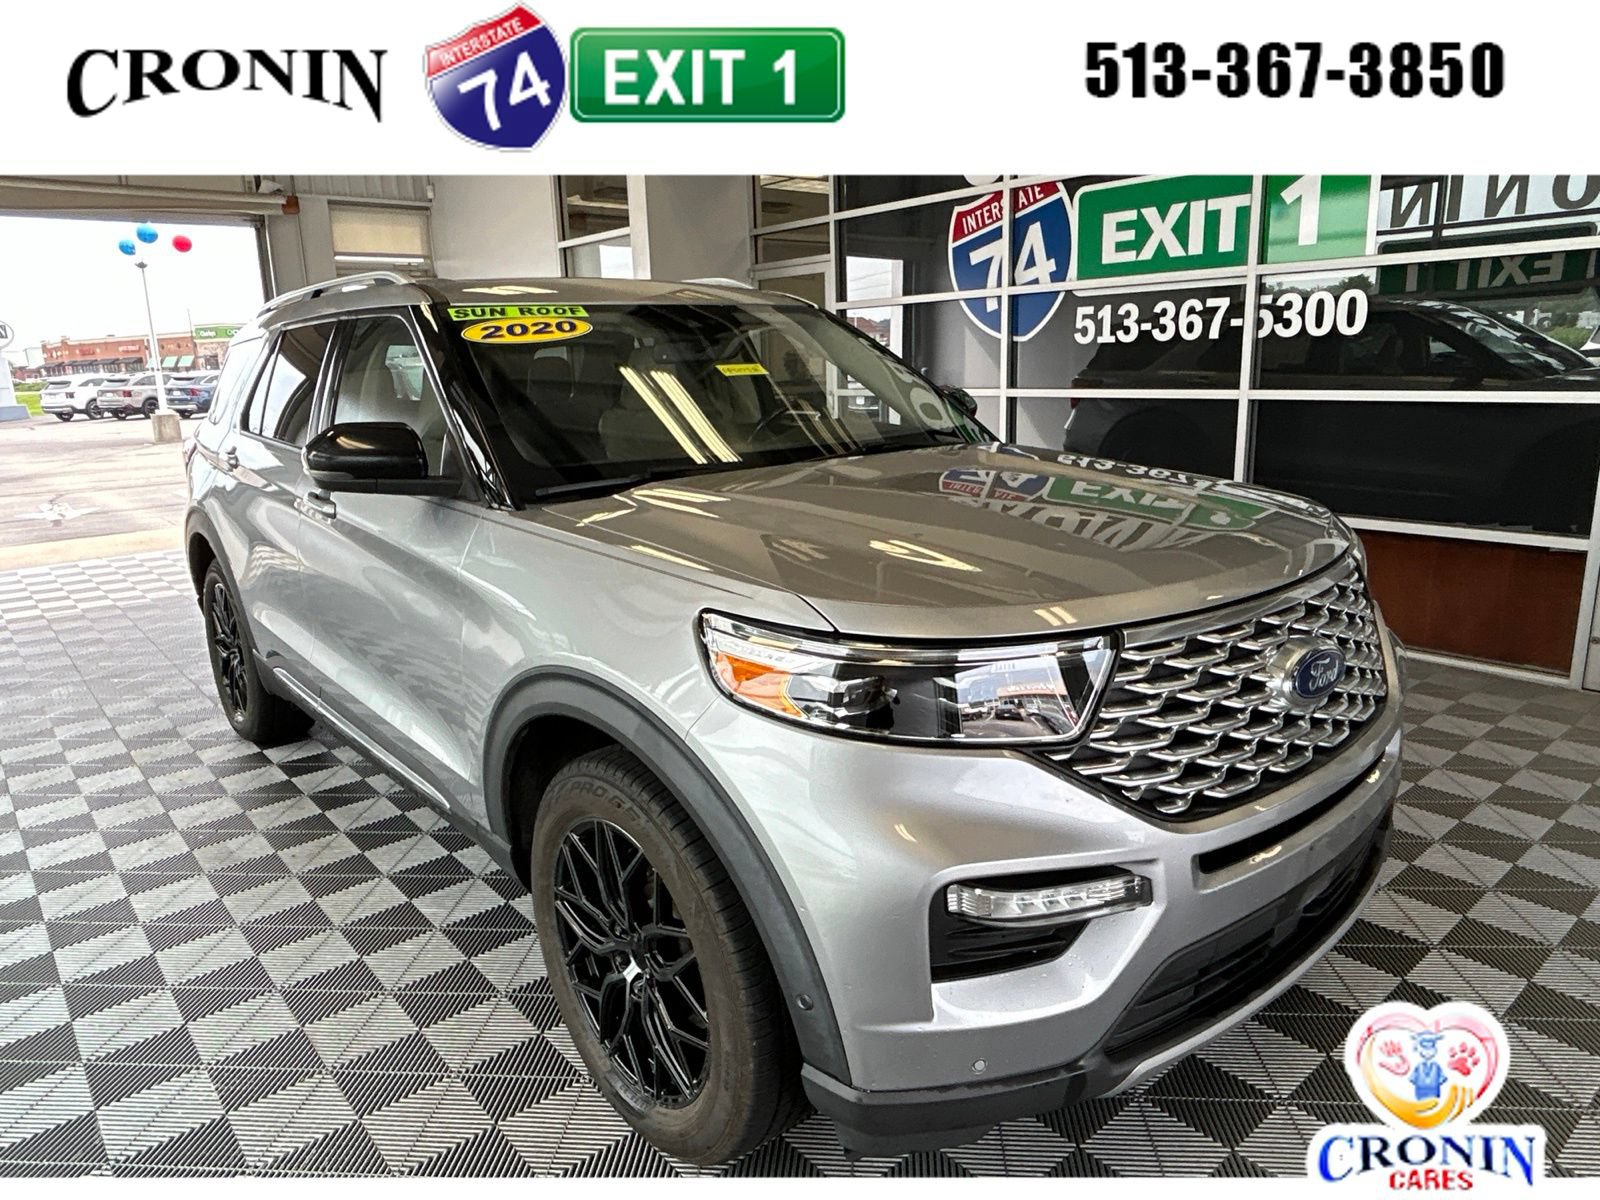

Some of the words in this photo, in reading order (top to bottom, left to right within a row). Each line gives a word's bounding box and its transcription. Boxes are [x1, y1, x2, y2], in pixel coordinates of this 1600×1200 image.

[962, 185, 1045, 235] INTERATE
[1101, 193, 1251, 265] EXIT
[1280, 174, 1322, 247] 1
[969, 221, 1057, 311] 74
[454, 307, 506, 318] SUN
[519, 307, 581, 316] ROOF
[480, 320, 577, 340] 2020
[1073, 288, 1369, 345] 513-367-5300
[1308, 657, 1340, 692] Ford
